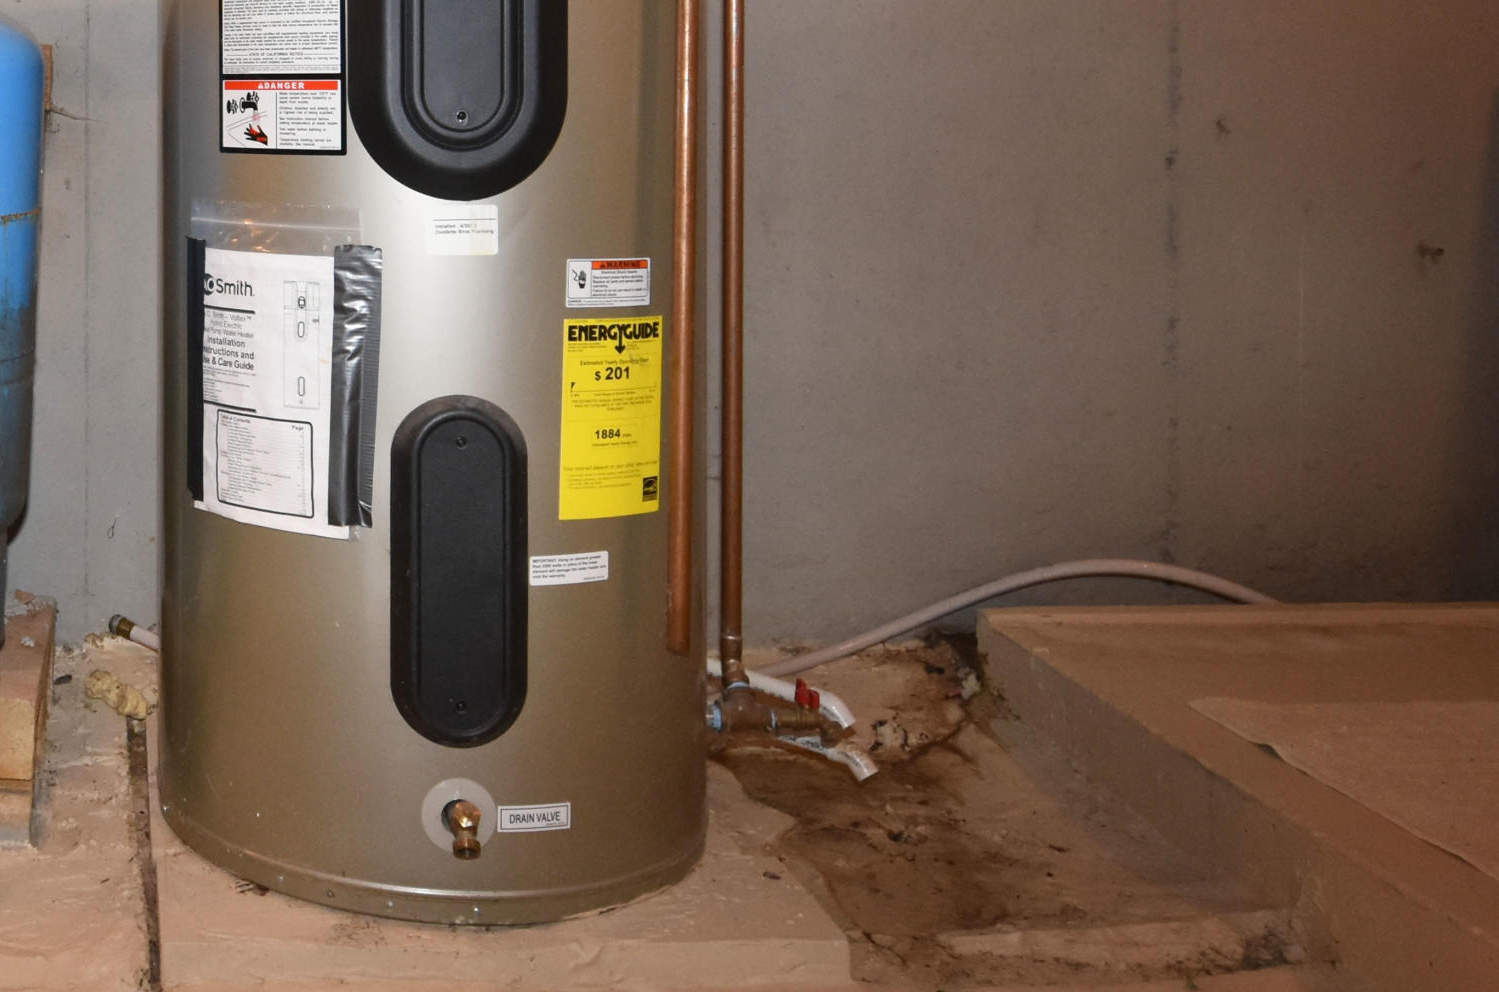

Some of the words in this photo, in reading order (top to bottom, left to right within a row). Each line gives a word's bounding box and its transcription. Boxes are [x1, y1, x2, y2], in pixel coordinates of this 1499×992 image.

[265, 81, 305, 89] DANGER
[567, 321, 660, 342] ENERGYGUIDE
[207, 336, 246, 348] Installation
[240, 351, 255, 360] and
[217, 357, 233, 368] Care
[234, 360, 255, 371] Guide
[605, 366, 631, 381] 201
[594, 428, 621, 440] 1884
[509, 813, 535, 824] DRAIN
[535, 811, 561, 822] VALVE
